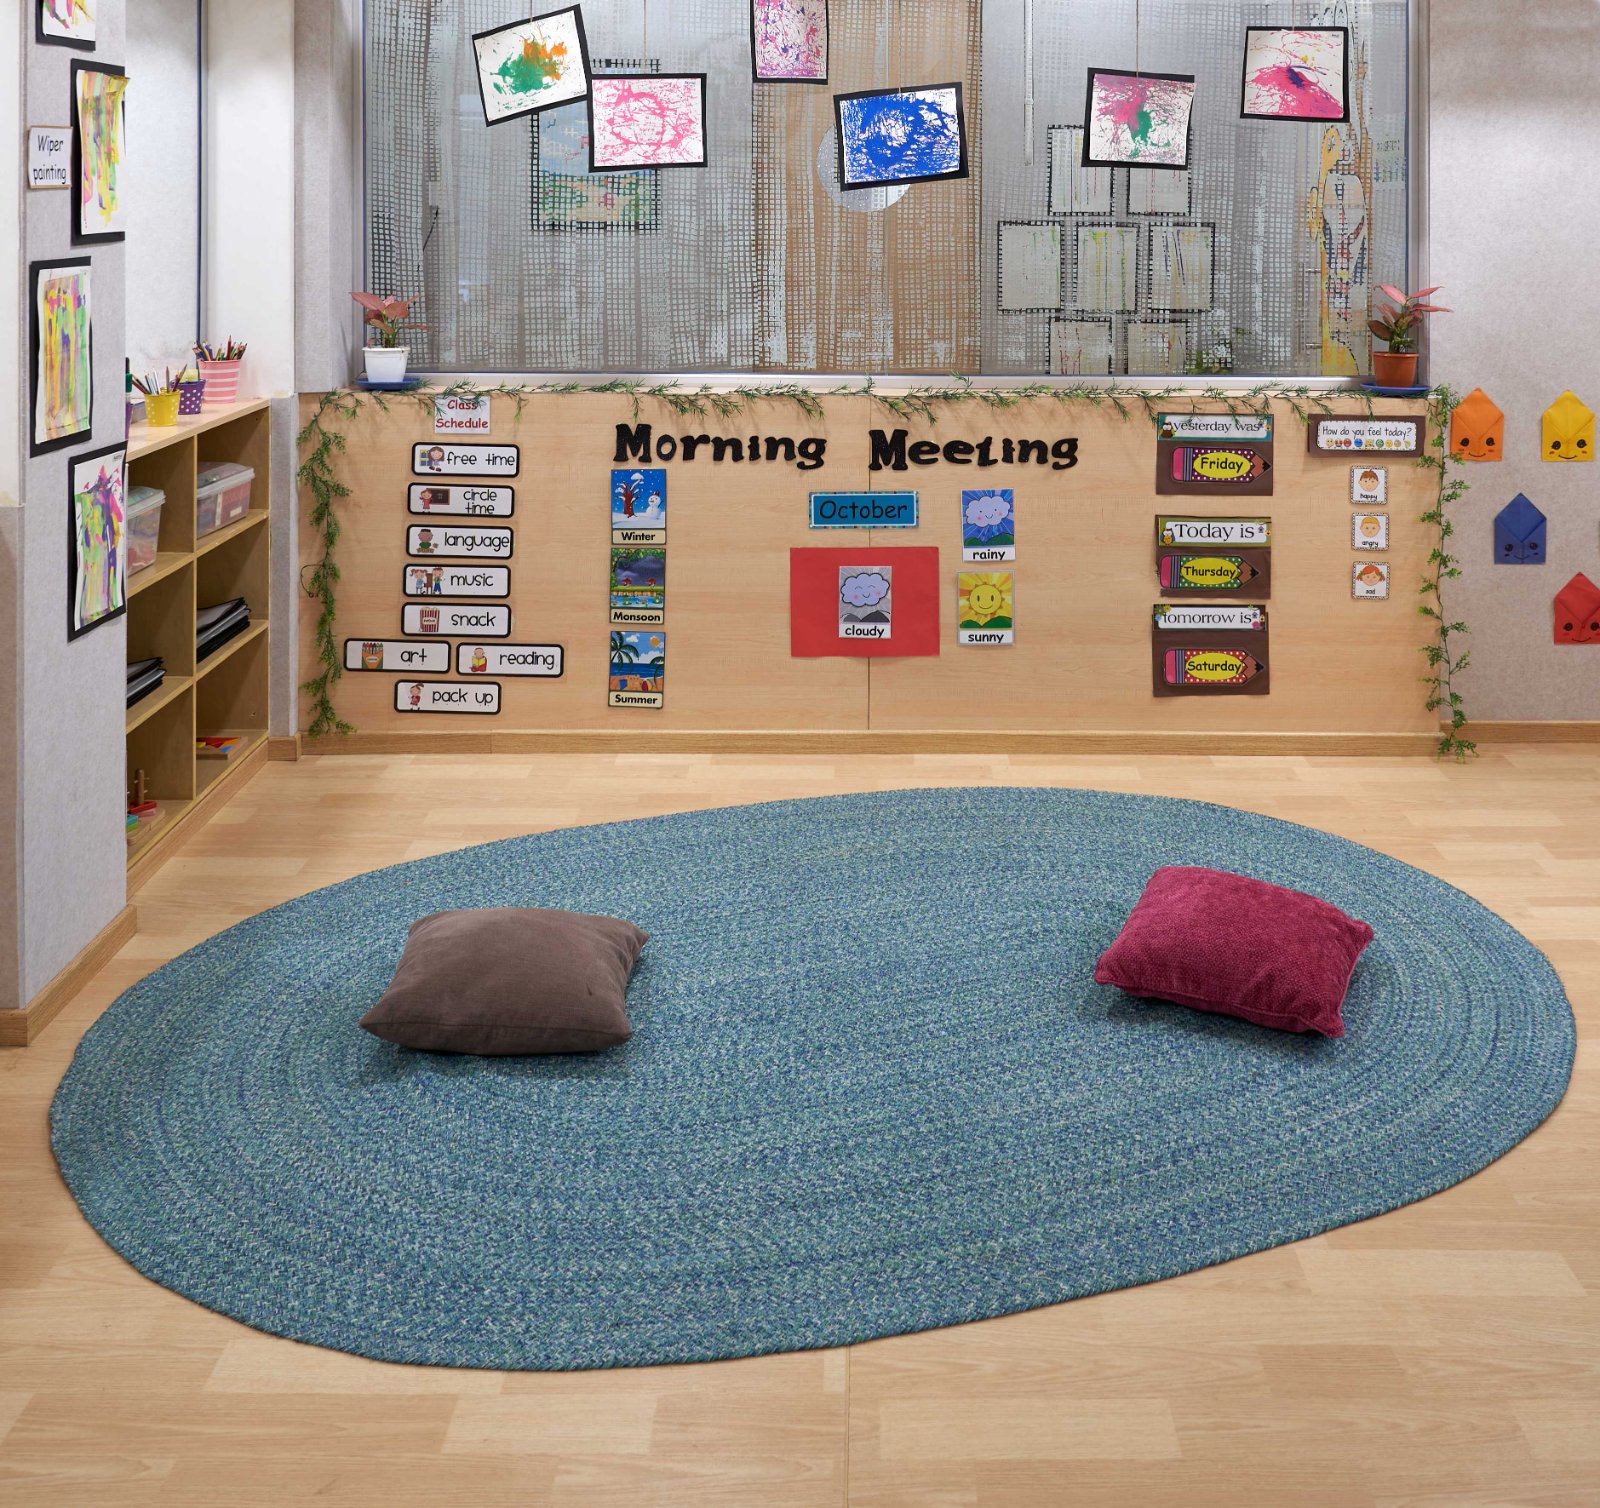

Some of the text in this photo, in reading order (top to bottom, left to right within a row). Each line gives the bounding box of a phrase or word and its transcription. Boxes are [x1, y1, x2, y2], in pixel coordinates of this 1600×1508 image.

[37, 135, 64, 157] Wiper
[33, 164, 67, 185] painting
[447, 399, 479, 410] Class
[435, 417, 489, 429] Schedule
[1173, 421, 1261, 434] yesterday was
[1322, 425, 1412, 440] How do you feel today?
[613, 423, 1079, 471] Morning Meeting
[446, 451, 515, 466] free time
[1200, 457, 1244, 474] Friday
[463, 488, 498, 502] circle
[1360, 492, 1378, 501] happy
[465, 502, 495, 515] time
[819, 500, 908, 520] October
[621, 531, 656, 542] Winter
[1174, 523, 1255, 542] Today is
[444, 532, 510, 552] language
[1361, 540, 1379, 548] angry
[972, 549, 1006, 561] rainy
[1184, 566, 1237, 579] Thursday
[450, 572, 494, 588] music
[451, 611, 497, 627] snack
[613, 611, 661, 622] Monsoon
[1163, 612, 1252, 624] tomorrow is
[844, 624, 885, 639] cloudy
[968, 632, 1004, 644] sunny
[400, 648, 428, 663] art
[499, 651, 555, 670] reading
[1187, 660, 1242, 674] Saturday
[432, 687, 494, 707] pack up
[615, 694, 658, 705] Summer
